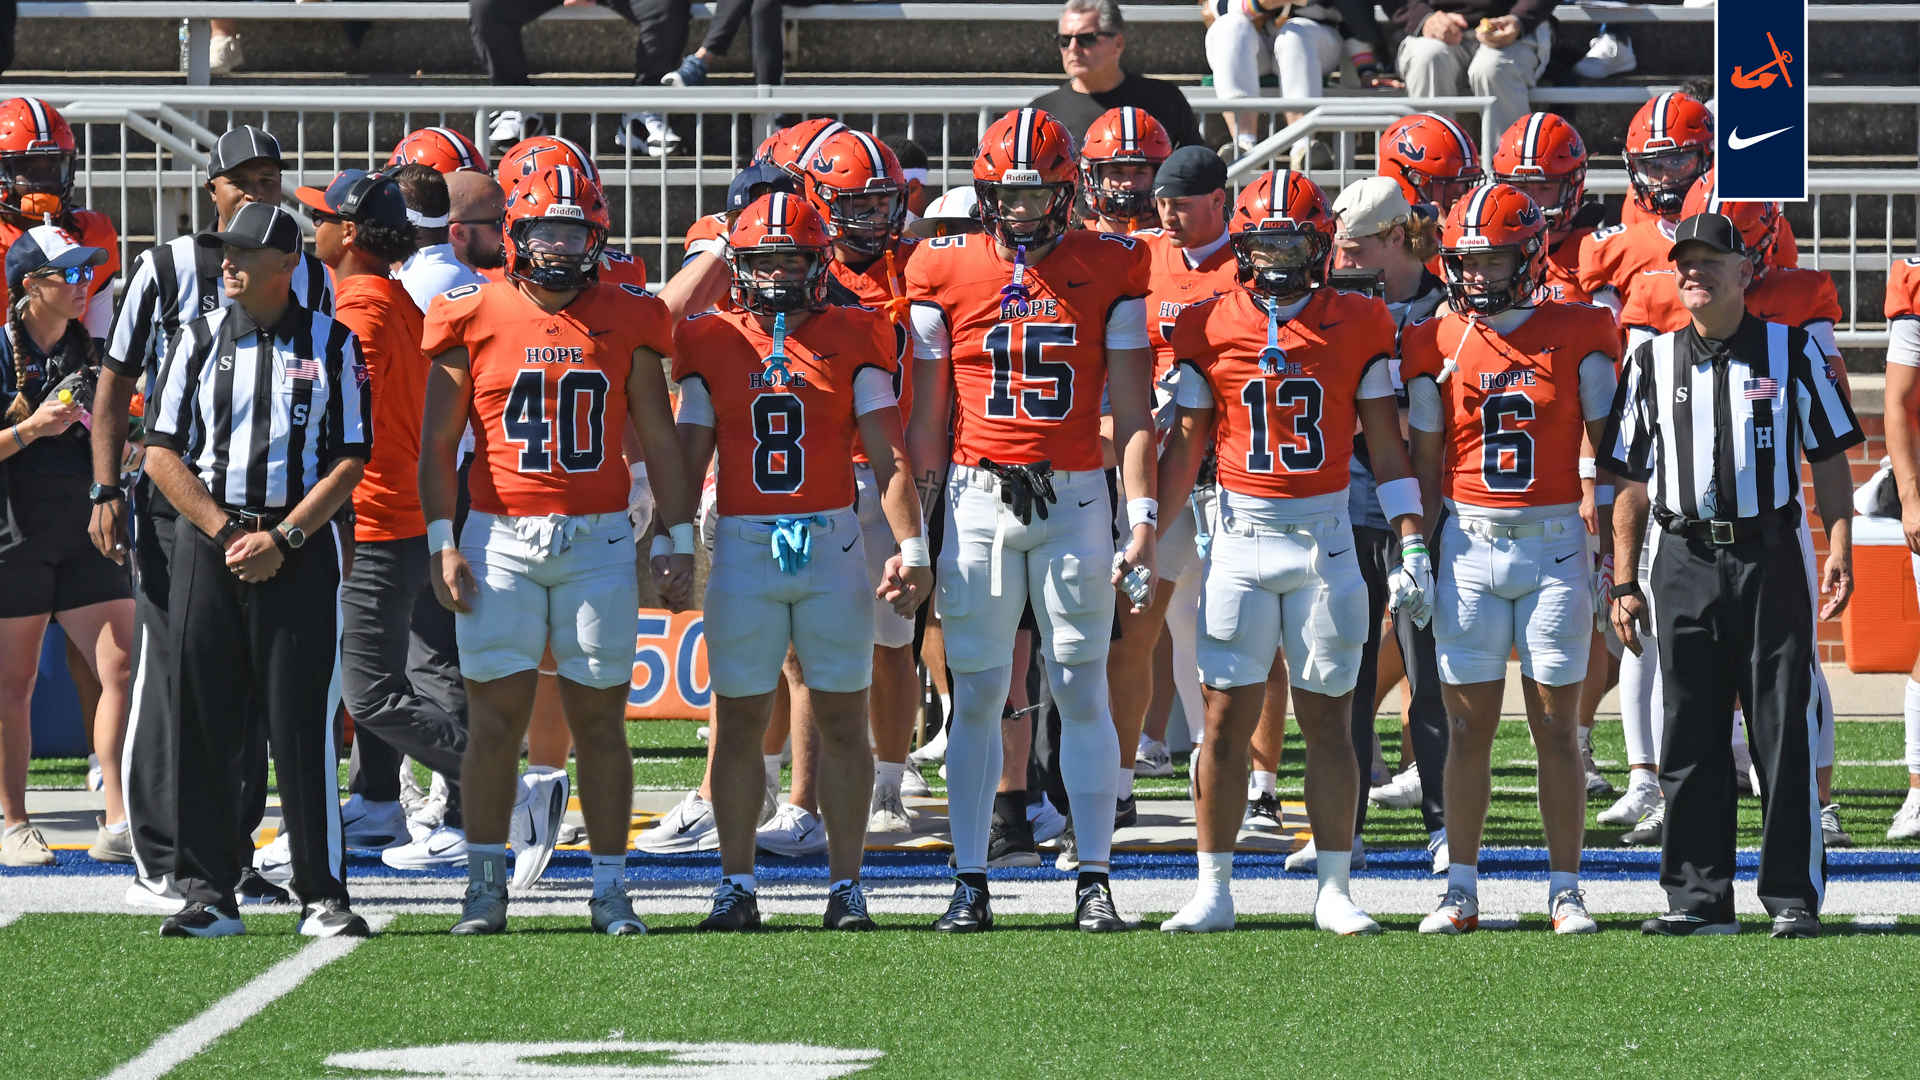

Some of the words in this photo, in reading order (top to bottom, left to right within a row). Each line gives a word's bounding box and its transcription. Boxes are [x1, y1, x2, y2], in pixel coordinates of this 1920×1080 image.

[1006, 174, 1038, 183] Riddell
[550, 207, 581, 217] Riddell
[1263, 221, 1291, 229] HOPE
[1531, 284, 1565, 301] OPE
[203, 295, 215, 311] S
[1000, 299, 1058, 320] HOPE
[1158, 301, 1190, 318] HO
[219, 355, 232, 371] S
[525, 347, 583, 364] HOPE
[981, 322, 1077, 420] 15
[1263, 363, 1321, 375] HOPE
[1479, 369, 1537, 390] HOPE
[1675, 386, 1688, 404] S
[293, 403, 307, 426] S
[501, 368, 610, 473] 40
[1241, 377, 1325, 473] 13
[751, 393, 805, 494] 8
[1481, 390, 1536, 492] 6
[1755, 426, 1773, 449] H
[626, 614, 712, 709] 50
